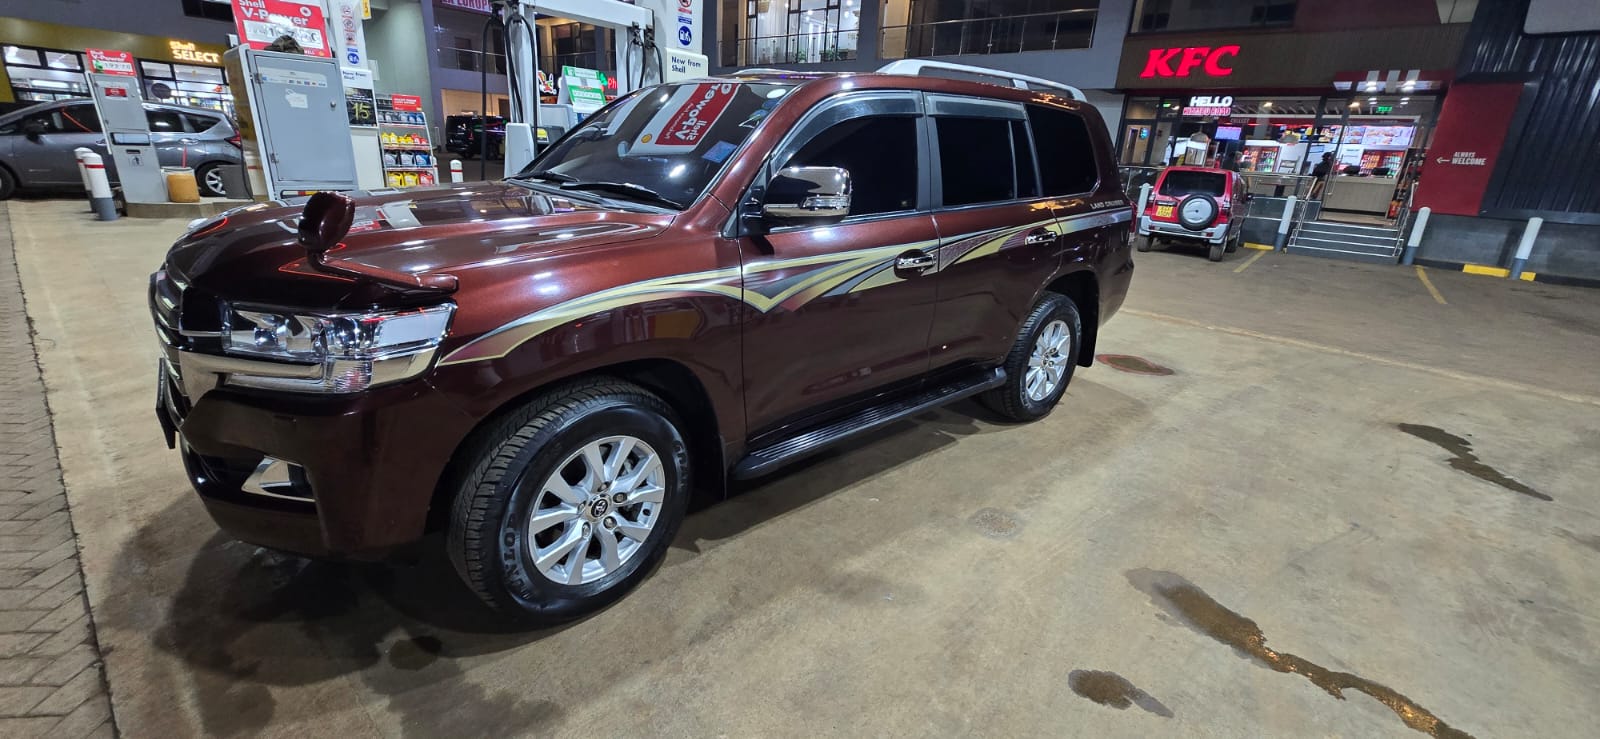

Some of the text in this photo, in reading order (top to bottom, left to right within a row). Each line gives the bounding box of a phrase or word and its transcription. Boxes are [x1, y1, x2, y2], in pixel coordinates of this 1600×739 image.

[239, 0, 265, 8] Shell
[241, 7, 308, 26] V-Pwer
[172, 49, 220, 63] SELECT
[1140, 45, 1240, 78] KFC
[671, 56, 702, 68] New from
[671, 64, 686, 73] Shell
[1190, 96, 1233, 107] HELLO
[1451, 157, 1487, 165] WELCOME
[1089, 201, 1105, 209] LAND
